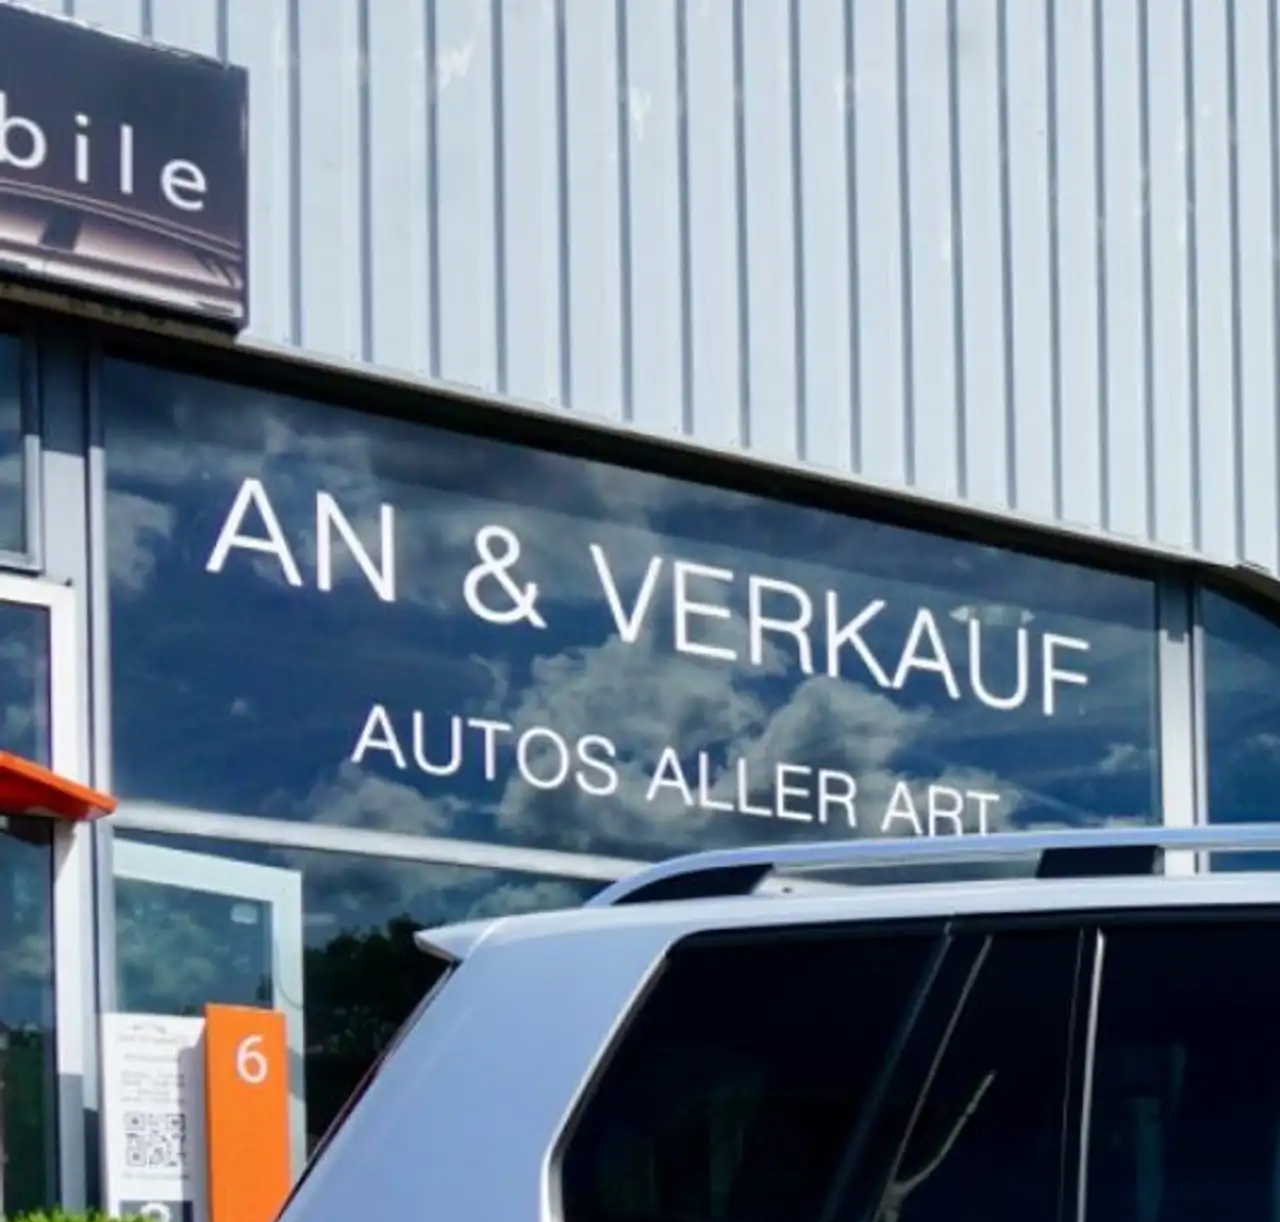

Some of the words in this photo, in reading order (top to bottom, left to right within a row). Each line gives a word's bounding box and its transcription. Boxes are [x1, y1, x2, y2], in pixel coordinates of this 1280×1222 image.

[0, 90, 207, 211] bile
[206, 477, 396, 602] AN
[462, 525, 547, 628] &
[590, 543, 1091, 716] VERKAUF
[351, 704, 619, 796] AUTOS
[646, 746, 857, 827] ALLER
[881, 780, 1000, 837] ART
[236, 1034, 268, 1084] 6
